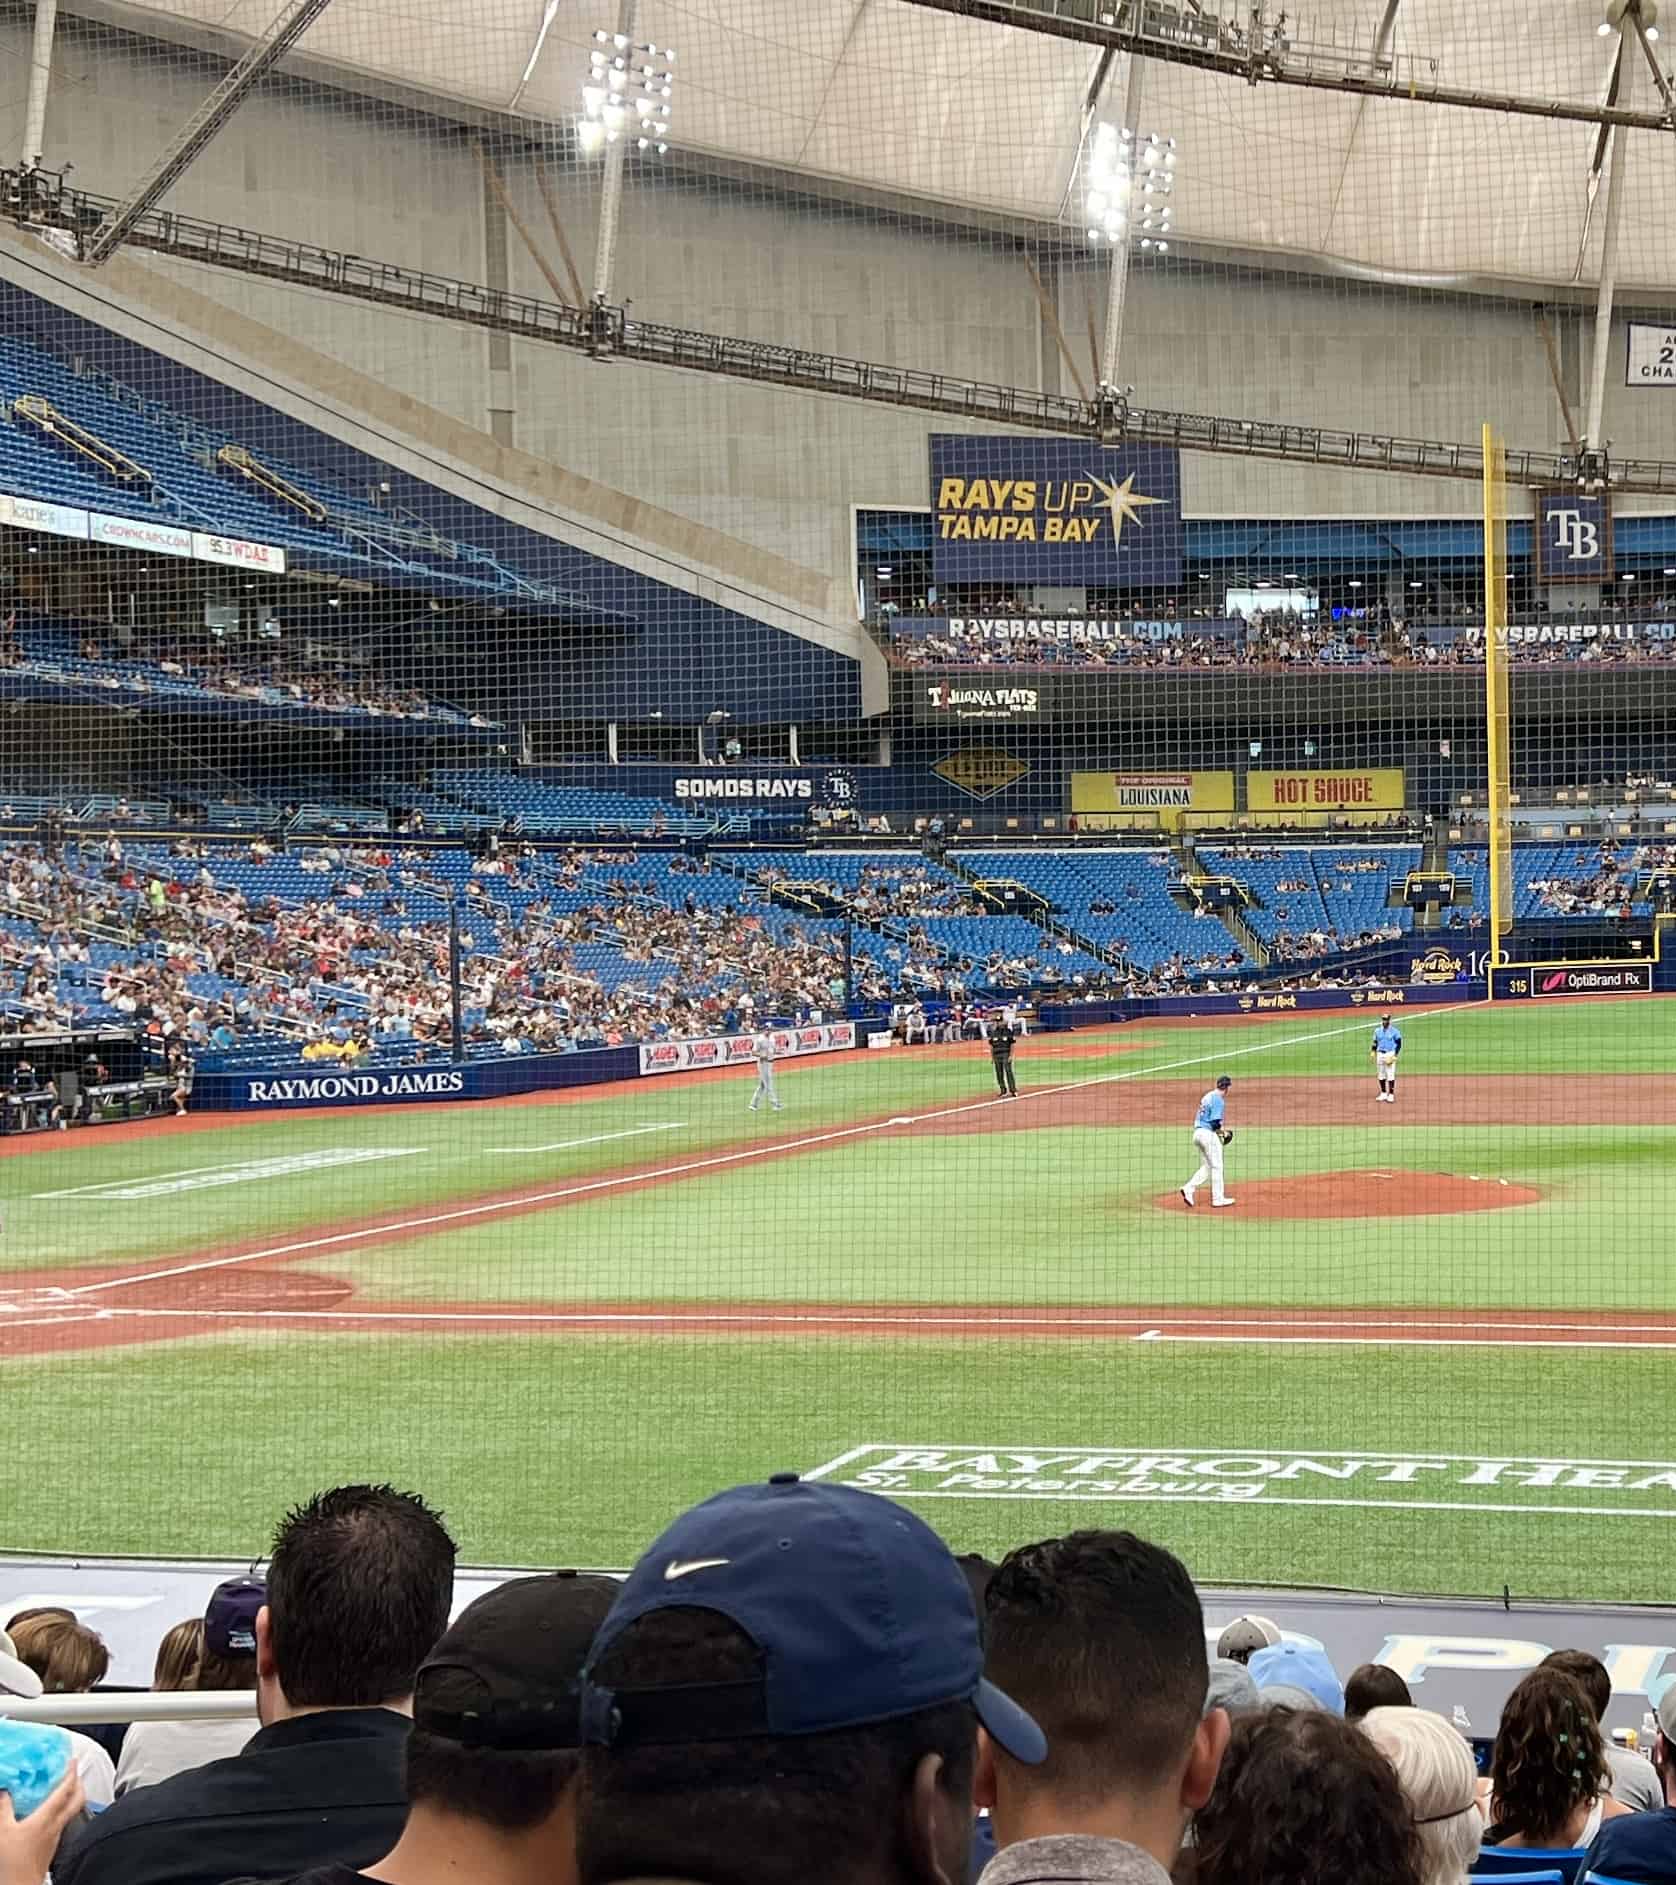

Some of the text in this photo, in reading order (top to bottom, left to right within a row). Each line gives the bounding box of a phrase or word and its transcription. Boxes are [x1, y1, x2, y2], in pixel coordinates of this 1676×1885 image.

[938, 478, 1094, 513] RAYS UP
[938, 514, 1100, 543] TAMPA BAY
[1546, 510, 1599, 559] TB
[675, 779, 811, 797] SOMOS RAYS
[829, 778, 850, 798] TB
[1120, 787, 1191, 807] LOUISIANA
[1274, 778, 1373, 803] HOT SAUCE
[1411, 957, 1462, 975] Hard Rock
[1509, 980, 1527, 993] 315
[1568, 972, 1640, 989] OptiBrand Rx
[1257, 995, 1276, 1008] Hard
[1277, 995, 1296, 1009] Rock
[1368, 990, 1386, 1002] Hard
[1386, 989, 1404, 1003] Rock
[248, 1072, 463, 1101] RAYMOND JAMES
[863, 1449, 1449, 1482] BAYFRONT
[841, 1471, 1268, 1498] St. Petersburg
